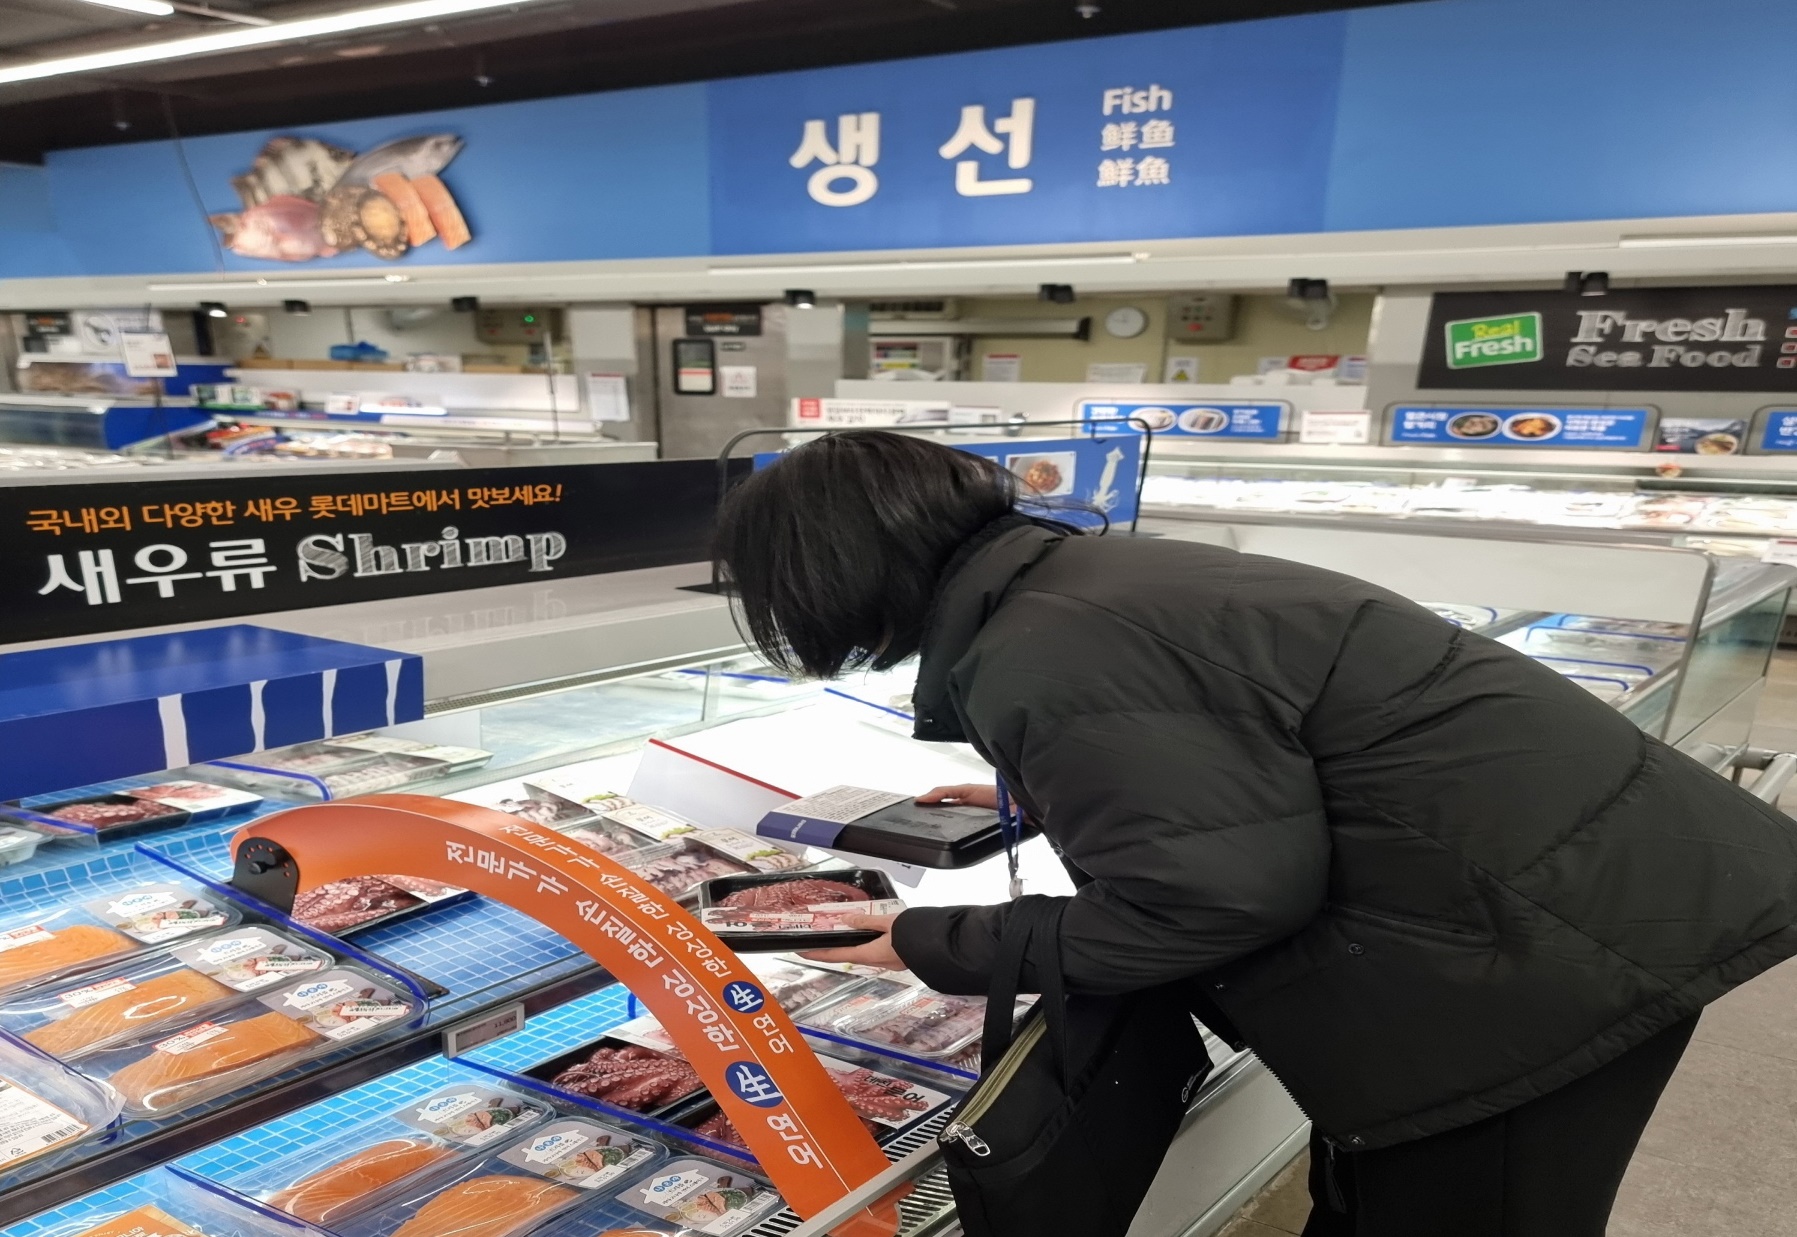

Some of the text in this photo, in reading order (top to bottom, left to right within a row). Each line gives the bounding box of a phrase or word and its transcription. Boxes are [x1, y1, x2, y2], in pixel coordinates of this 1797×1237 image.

[1103, 84, 1172, 116] Fish
[1472, 319, 1521, 341] Real
[1570, 308, 1767, 343] Fresh
[1455, 335, 1534, 360] Fresh
[1565, 345, 1763, 368] Sea Food
[26, 483, 563, 536] 국내외 다양한 새우 롯데마트에서 맛보세요!
[37, 525, 567, 606] 새우류 Shrimp
[499, 823, 794, 1055] 전문가가 손질한 싱싱한 生 연어
[445, 840, 824, 1169] 전문가가 손질한 싱싱한 生 연어
